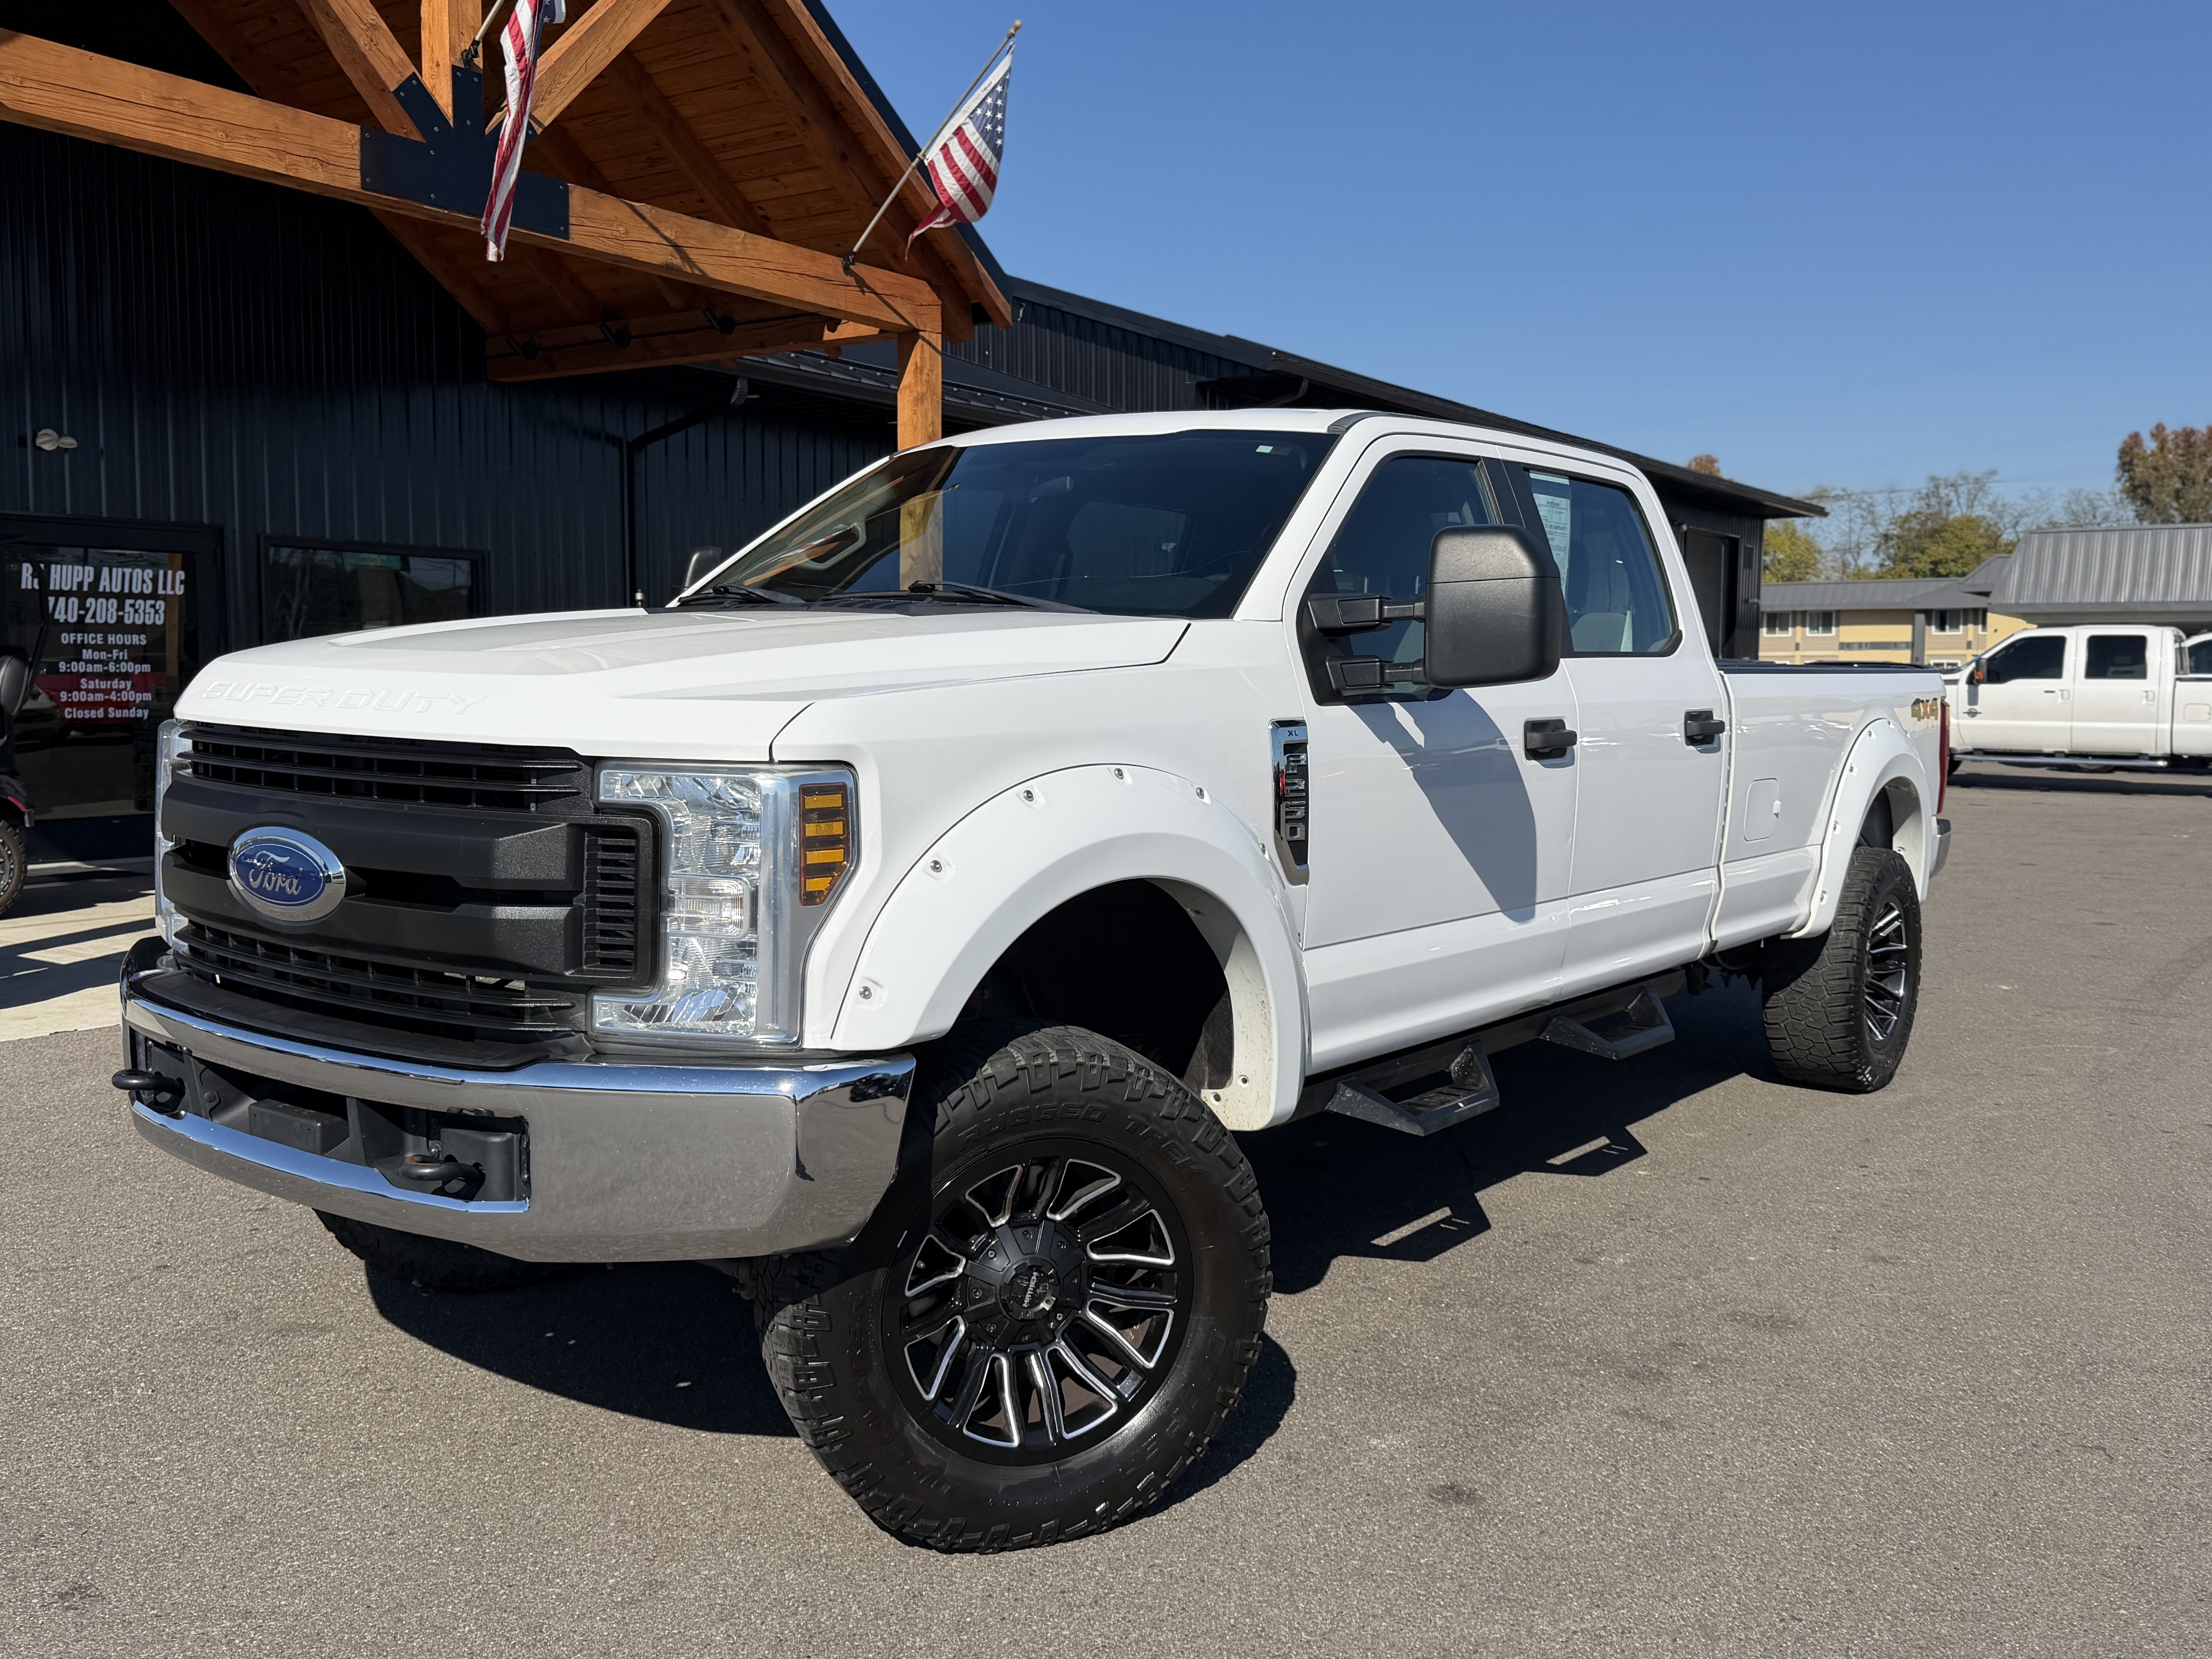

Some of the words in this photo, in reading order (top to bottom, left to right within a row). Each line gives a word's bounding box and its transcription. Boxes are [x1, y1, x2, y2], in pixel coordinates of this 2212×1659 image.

[50, 564, 94, 591] HUPP
[98, 567, 153, 594] AUTOS
[158, 570, 185, 595] LLC
[61, 633, 103, 644] OFFICE
[108, 634, 147, 645] HOURS
[82, 649, 128, 660] Mon-Fri
[59, 661, 151, 674] 9:00am-6:00pm
[80, 678, 132, 691] Saturday
[60, 691, 152, 703] 9:00am-4:00pm
[203, 681, 334, 707] SUPER
[335, 689, 487, 715] DUTY
[65, 707, 104, 718] Closed
[108, 708, 149, 720] Sunday
[243, 850, 303, 895] Ford
[958, 1103, 1109, 1151] RUGGED
[1125, 1115, 1202, 1181] TREK
